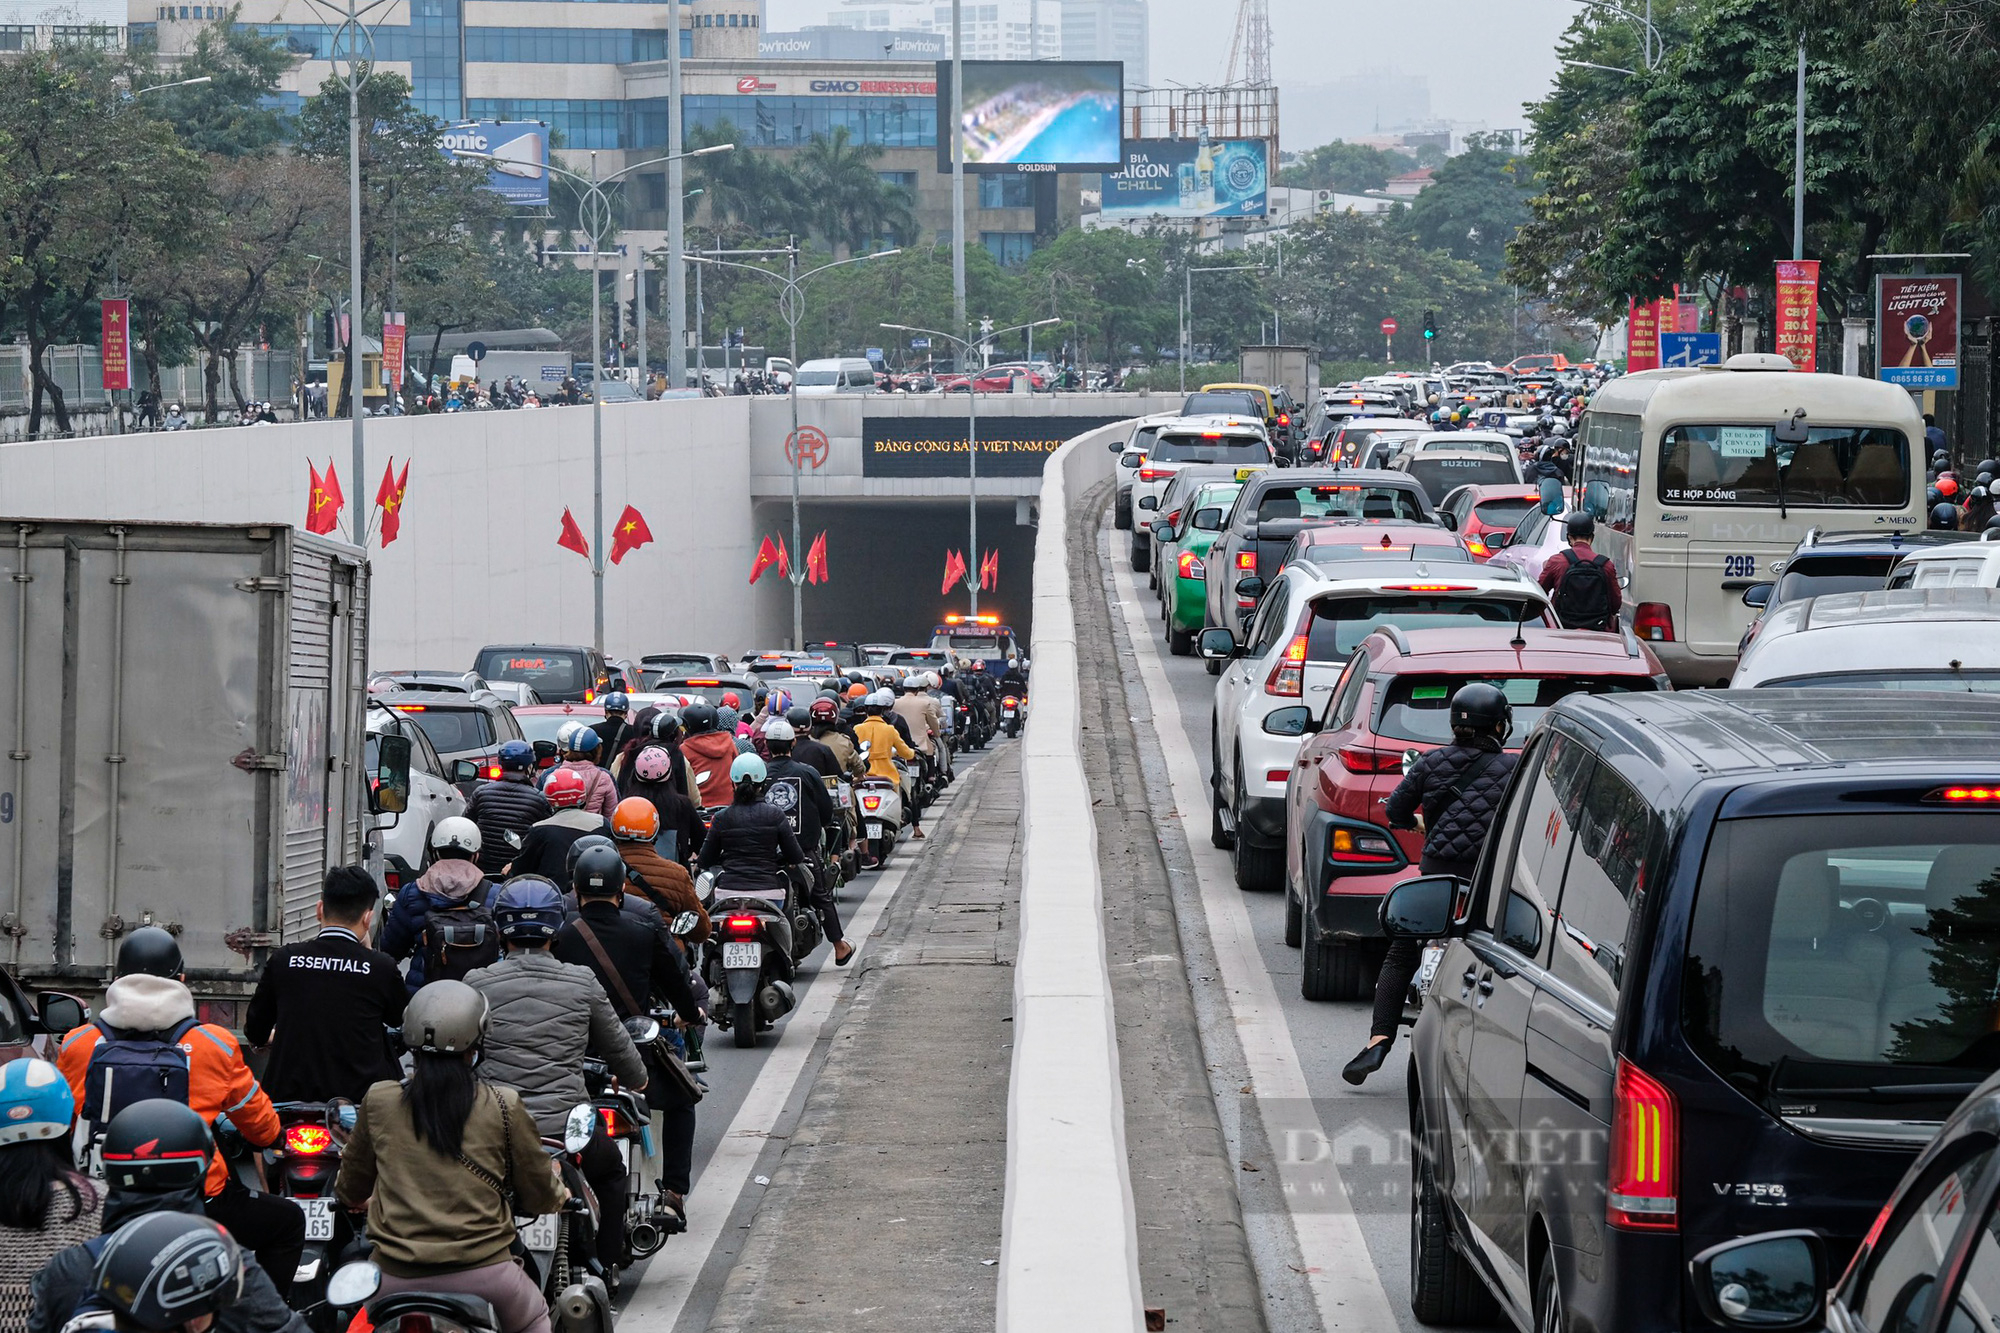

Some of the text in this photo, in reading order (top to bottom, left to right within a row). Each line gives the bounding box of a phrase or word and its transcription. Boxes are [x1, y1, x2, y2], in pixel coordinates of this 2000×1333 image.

[758, 38, 811, 53] owindow
[894, 37, 941, 53] Eurowindow
[810, 80, 859, 93] GMO
[1130, 154, 1149, 163] BIA
[1017, 163, 1057, 172] GOLDSUN
[1117, 181, 1163, 191] CHILL
[1900, 282, 1940, 294] TIẾT KIỆM
[1888, 297, 1947, 311] LIGHT BOX
[1891, 375, 1947, 383] 0865 86 87 86
[1489, 414, 1501, 425] G7
[874, 438, 1064, 454] ĐẢNG CỘNG SẢN VIỆT NAM QU
[1441, 460, 1482, 468] SUZUKI
[1666, 489, 1680, 498] XE
[1683, 489, 1704, 500] HỢP
[1889, 516, 1917, 524] MEIKO
[1712, 523, 1801, 539] HYUN
[1724, 555, 1755, 577] 29B
[729, 944, 755, 955] 29-T1
[289, 955, 371, 975] ESSENTIALS
[726, 956, 758, 967] 835.79
[1713, 1182, 1732, 1195] V
[303, 1201, 326, 1218] -E2
